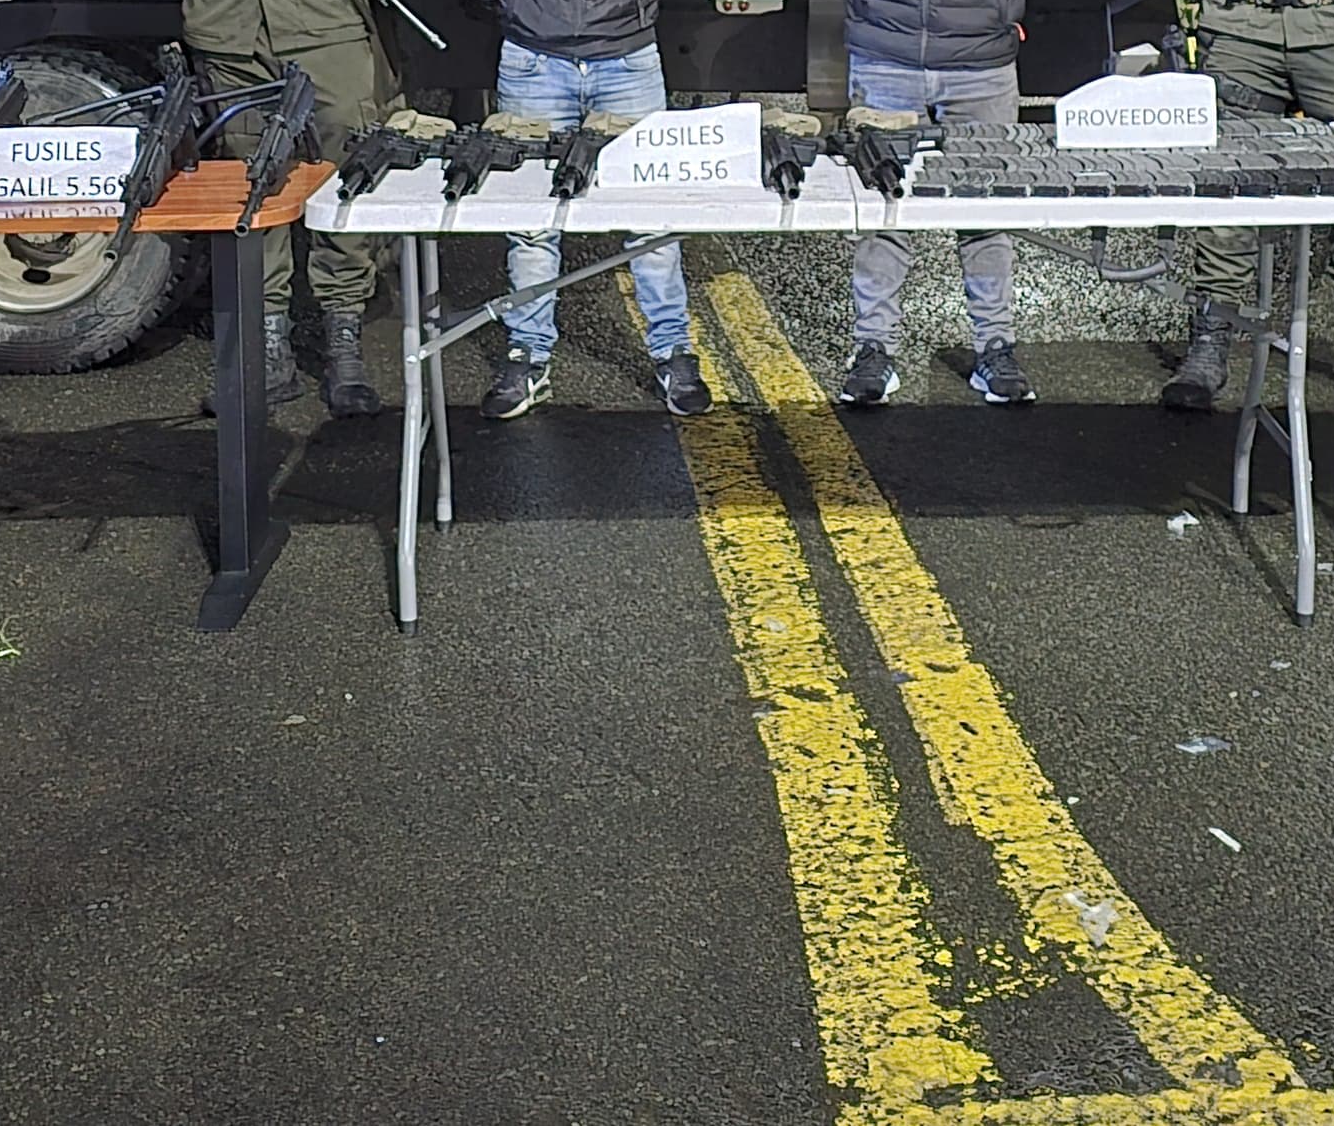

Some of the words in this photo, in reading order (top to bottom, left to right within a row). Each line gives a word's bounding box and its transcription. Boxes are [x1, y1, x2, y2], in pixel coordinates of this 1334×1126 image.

[1065, 107, 1209, 127] PROVEEDORES
[635, 125, 724, 148] FUSILES
[11, 141, 102, 163] FUSILES
[633, 162, 672, 183] M4
[678, 160, 729, 181] 5.56
[66, 176, 116, 196] 5.56
